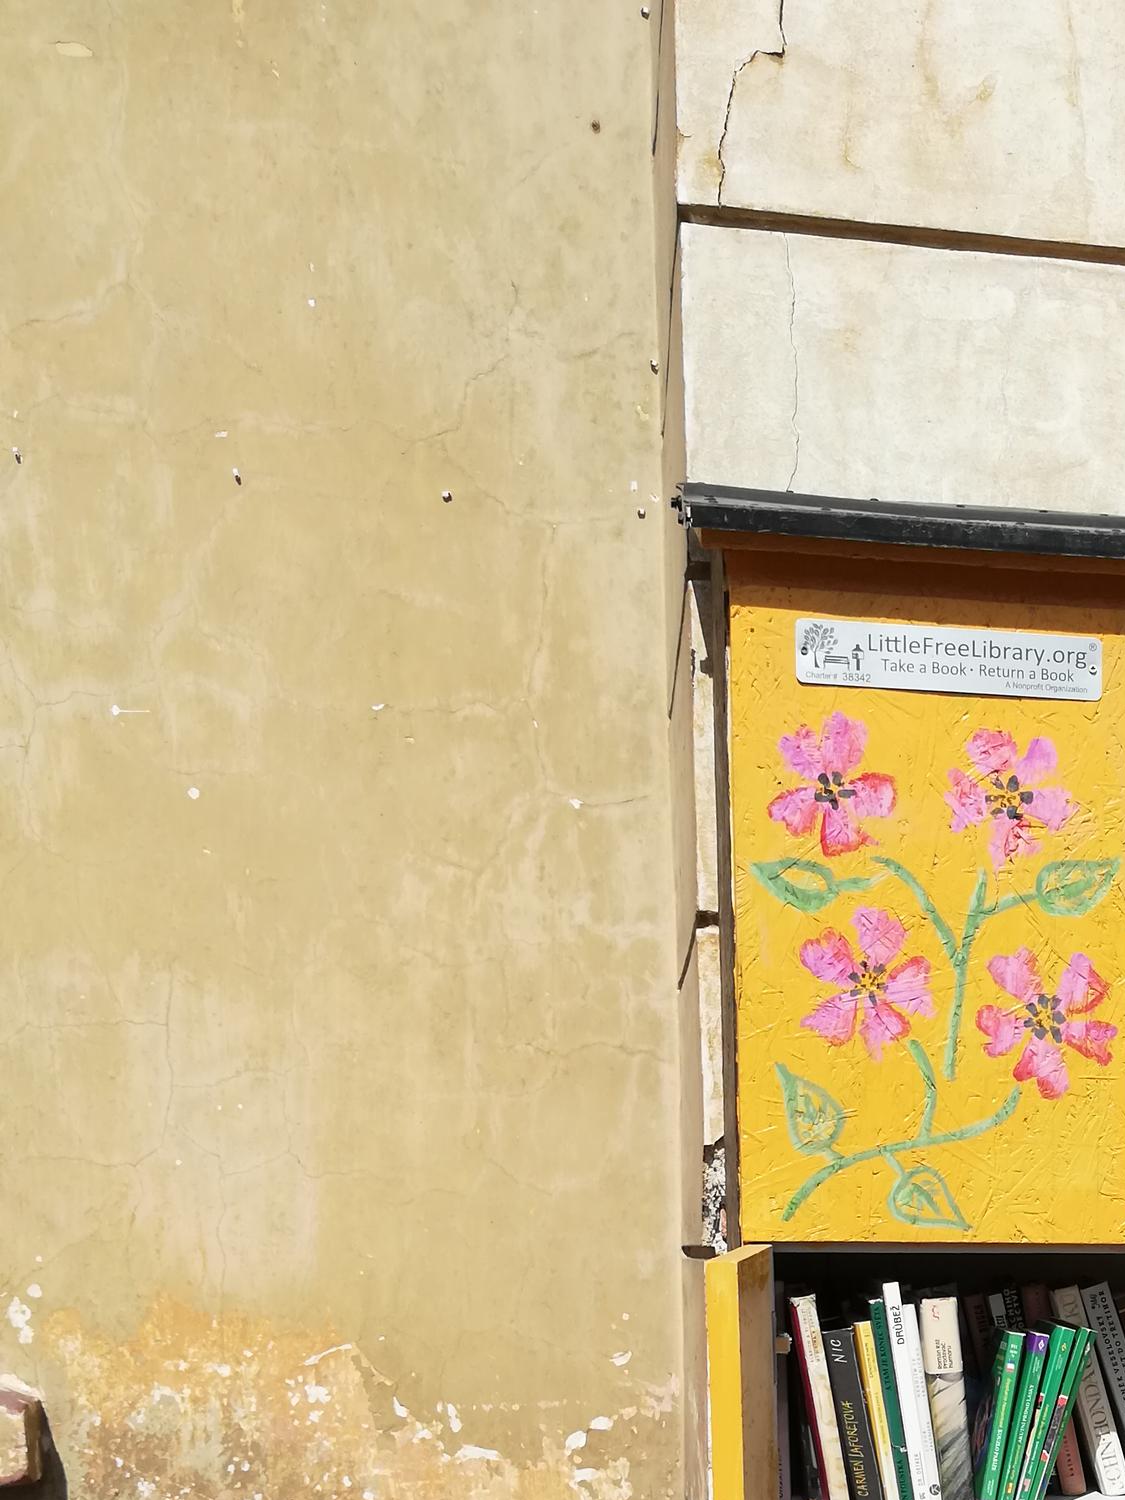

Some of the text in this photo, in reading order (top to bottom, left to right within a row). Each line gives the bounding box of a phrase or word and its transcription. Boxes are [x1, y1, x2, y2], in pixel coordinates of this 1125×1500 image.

[867, 633, 1087, 669] LittleFreeLibrary.org
[842, 672, 872, 683] 38342
[881, 658, 1074, 683] Take a Book Return a Book
[1012, 682, 1044, 692] Nonprofit
[1045, 683, 1088, 694] Organization
[888, 1302, 906, 1346] DRŮBEŽ
[830, 1336, 848, 1365] NIC
[855, 1458, 869, 1498] CARMEN
